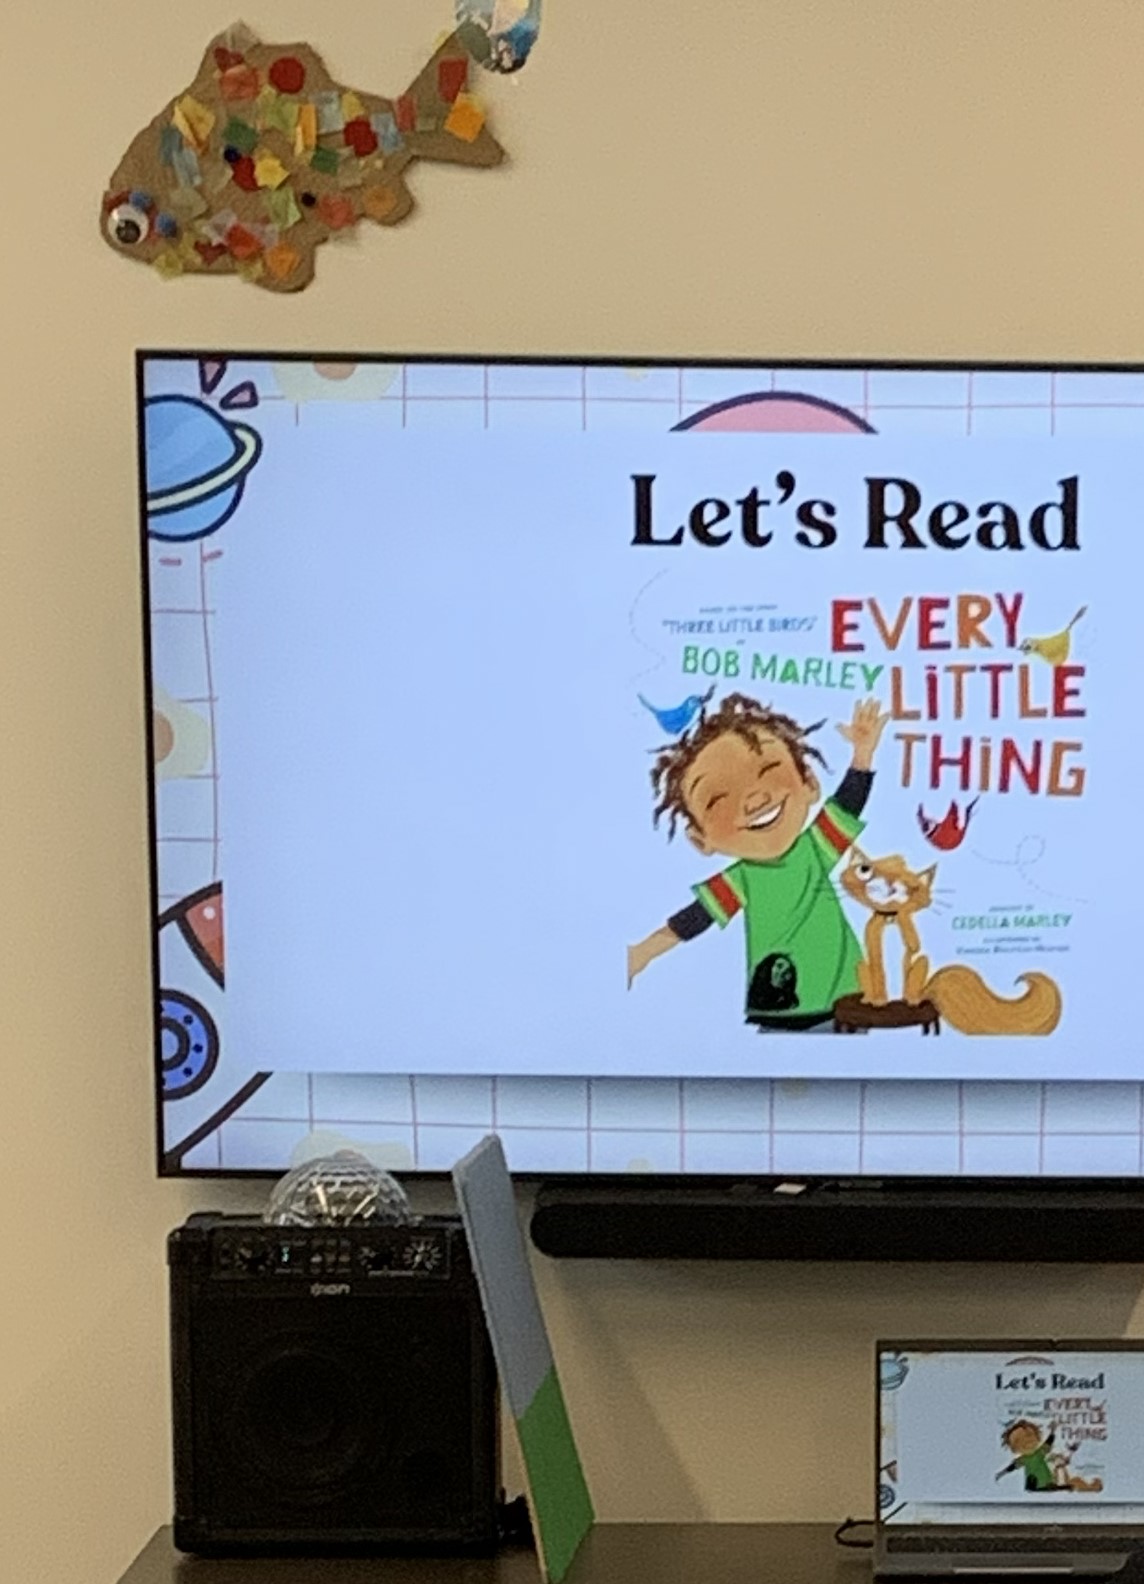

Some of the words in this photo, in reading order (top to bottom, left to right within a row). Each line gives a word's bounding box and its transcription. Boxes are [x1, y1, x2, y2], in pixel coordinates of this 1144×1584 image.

[630, 470, 838, 549] Let's
[863, 475, 1082, 551] Read
[831, 592, 1024, 653] EVERY
[682, 645, 740, 678] BOB
[751, 651, 884, 691] MARLEY
[1051, 1372, 1105, 1389] Read
